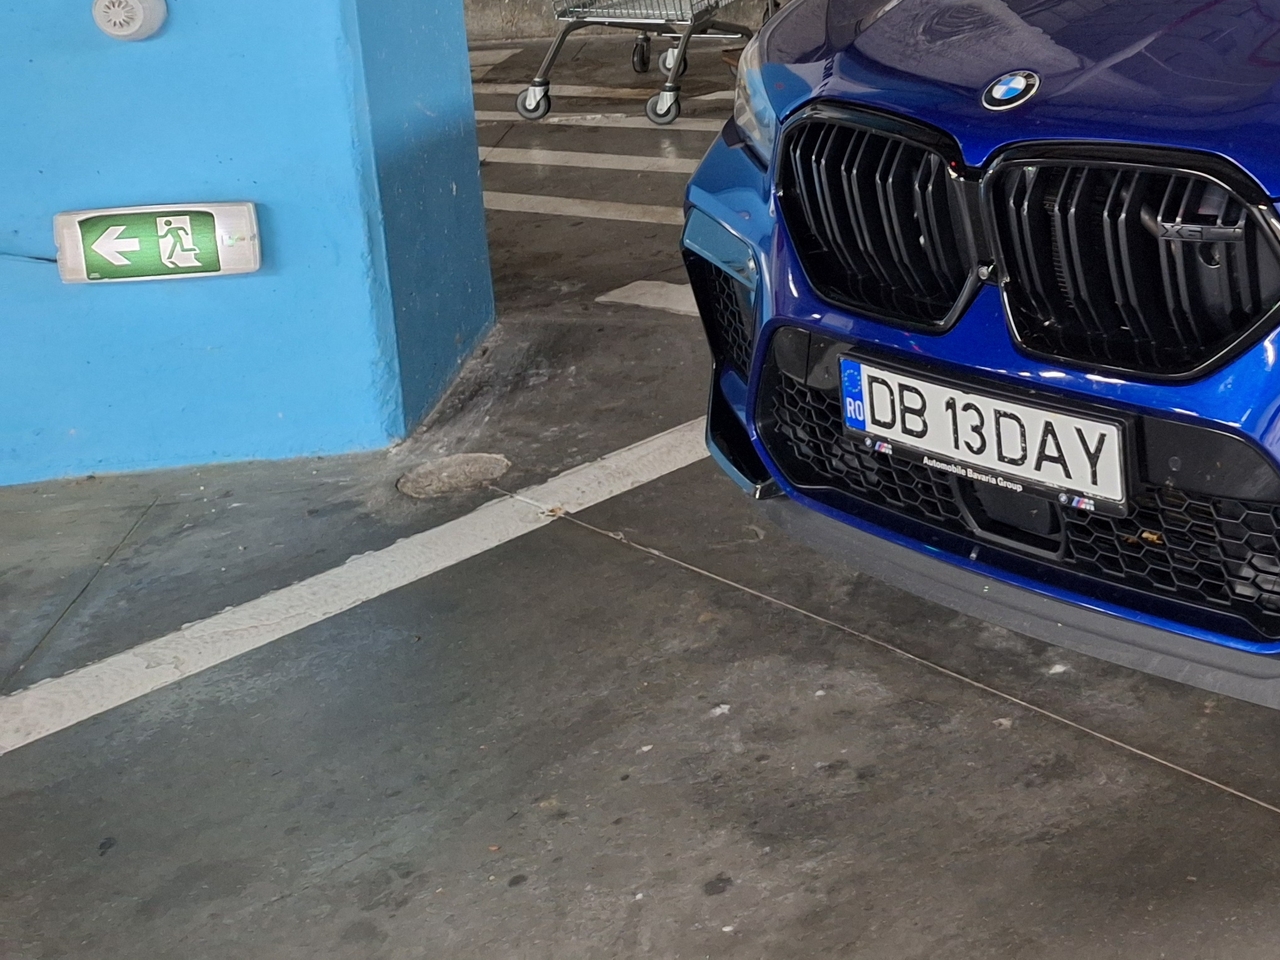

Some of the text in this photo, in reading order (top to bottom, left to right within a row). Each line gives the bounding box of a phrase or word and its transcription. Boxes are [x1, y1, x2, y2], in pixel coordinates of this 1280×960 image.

[846, 398, 864, 422] RO
[867, 374, 1107, 486] DB 13DAY
[923, 456, 1023, 492] Automobile Bavaria Group
